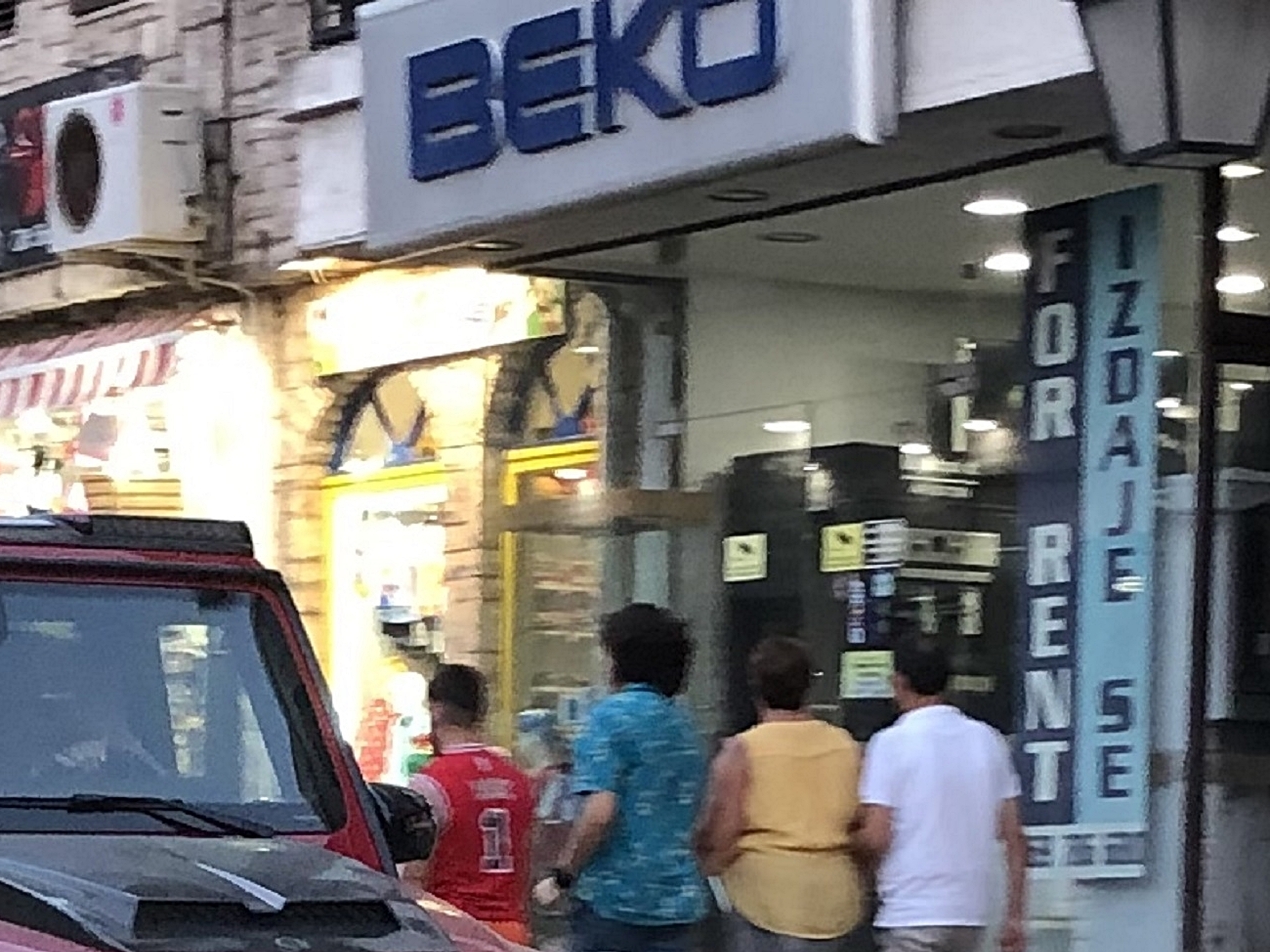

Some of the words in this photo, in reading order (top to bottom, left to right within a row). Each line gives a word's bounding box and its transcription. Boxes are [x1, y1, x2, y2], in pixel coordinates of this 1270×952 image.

[408, 0, 780, 182] BEKO
[1029, 228, 1078, 441] FOR
[1099, 214, 1144, 602] IZDAJE
[1023, 522, 1073, 802] RENT
[1097, 678, 1136, 798] SE
[478, 806, 515, 874] 1
